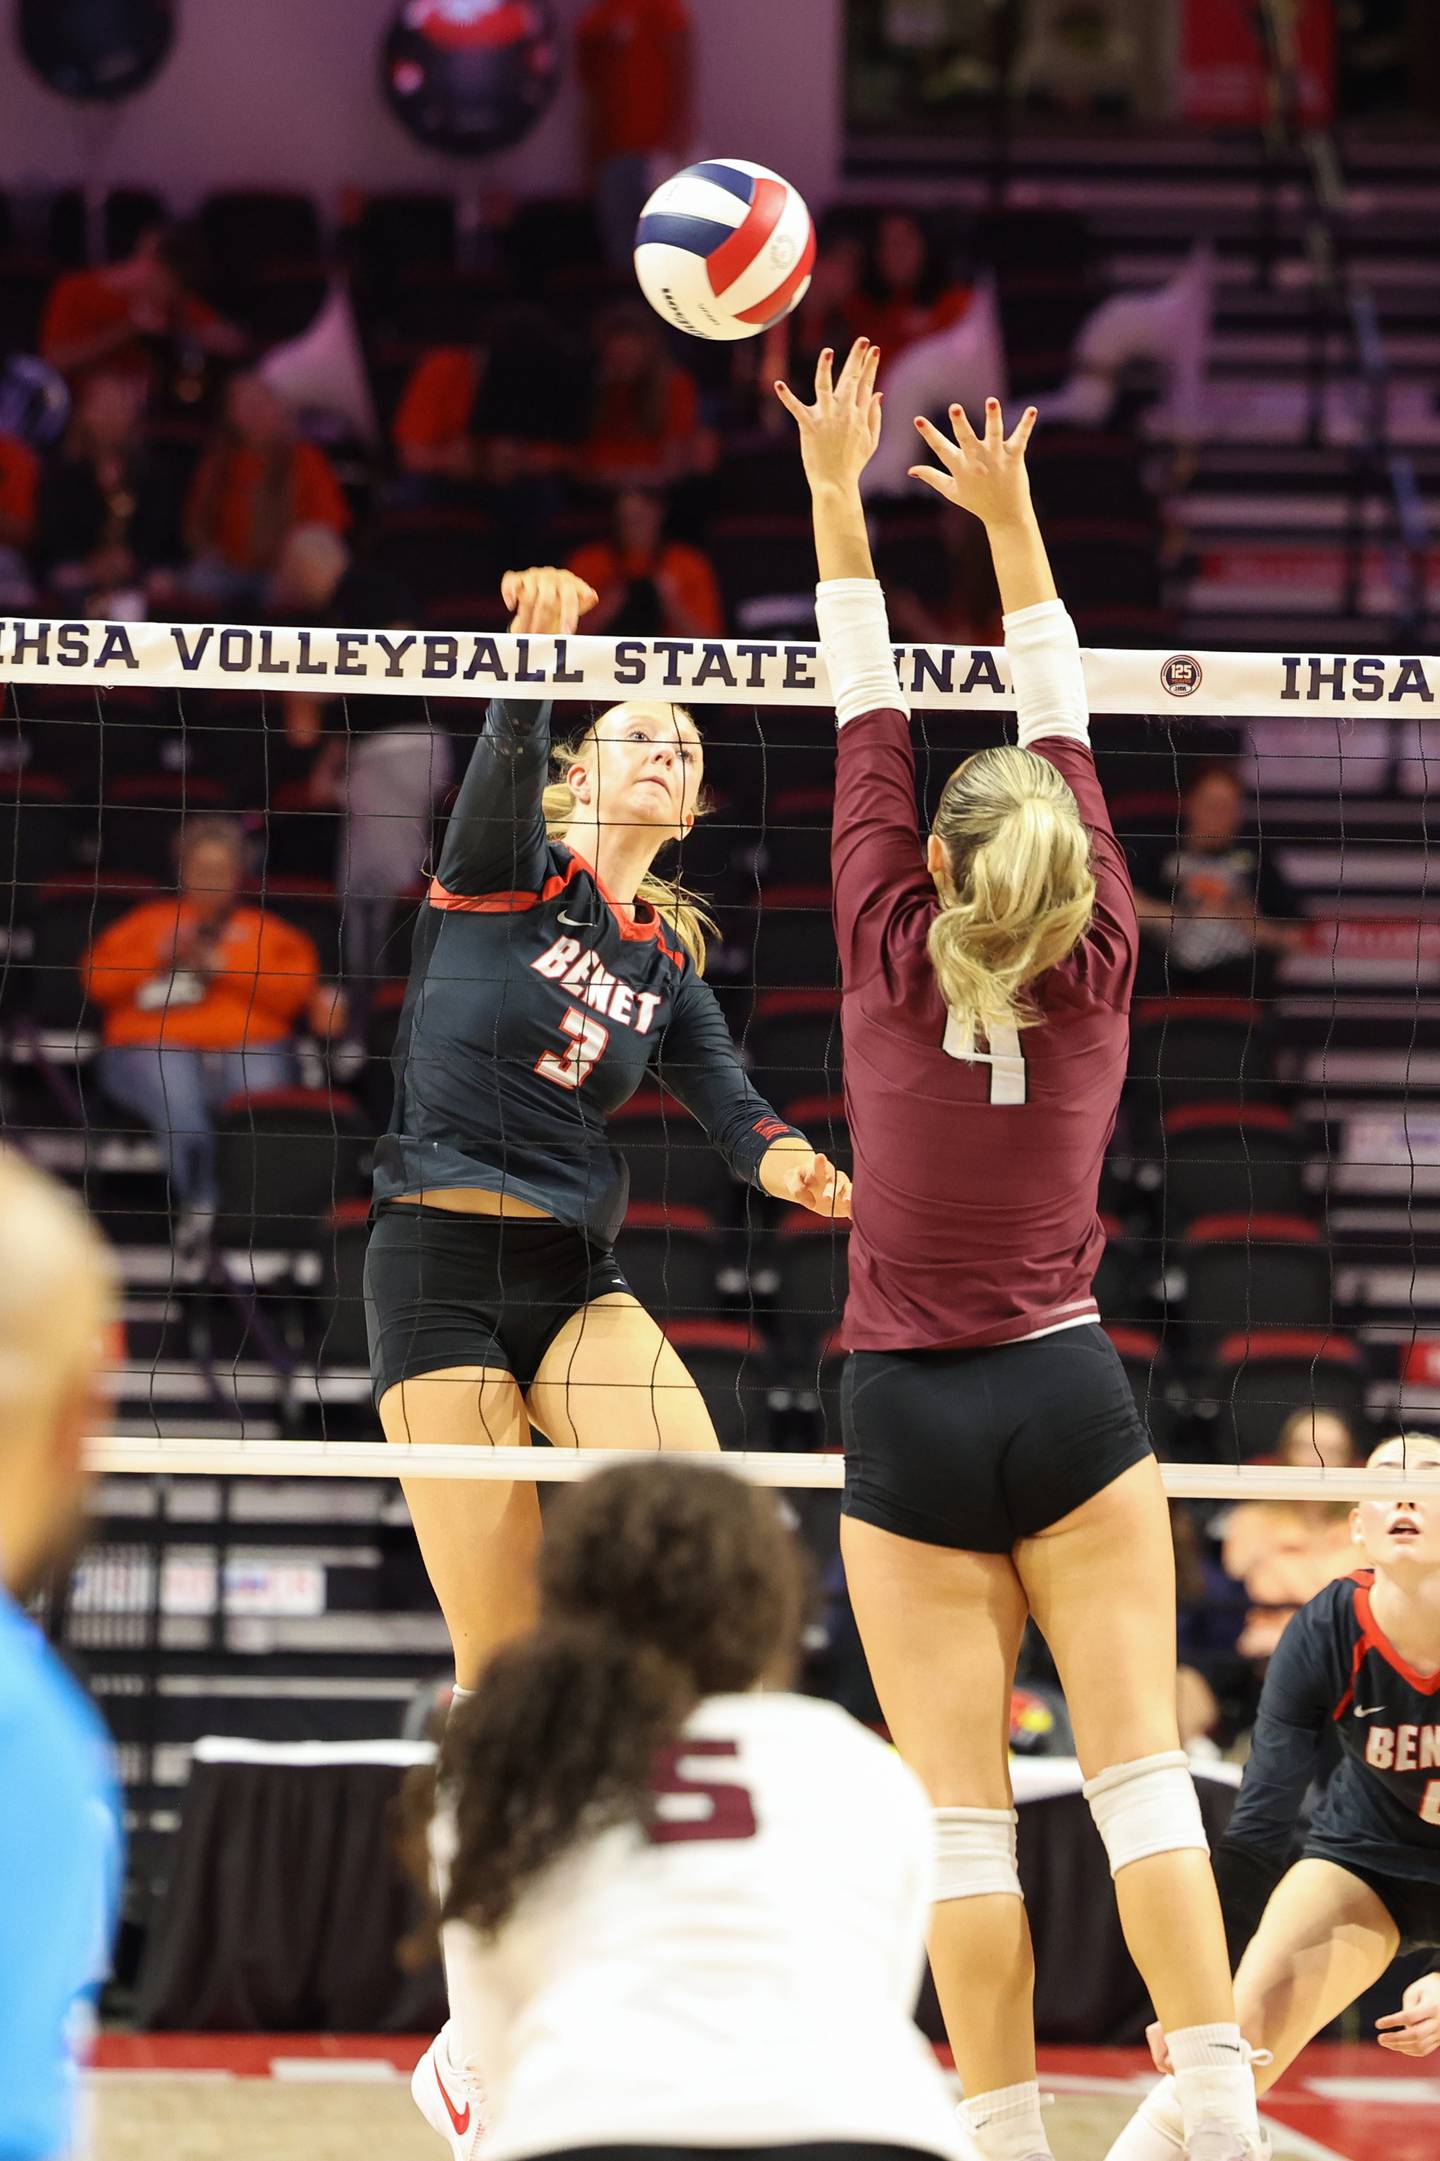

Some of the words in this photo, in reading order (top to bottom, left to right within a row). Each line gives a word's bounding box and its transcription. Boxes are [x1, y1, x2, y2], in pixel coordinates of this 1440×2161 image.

[171, 627, 584, 682] VOLLEYBALL
[613, 641, 817, 688] STATE
[1171, 664, 1192, 679] 125
[1281, 657, 1435, 702] IHSA
[529, 935, 661, 1035] BENET
[533, 1006, 609, 1090] 3
[942, 1002, 1026, 1105] 4
[1366, 1724, 1440, 1771] BEN
[648, 1740, 757, 1844] 5
